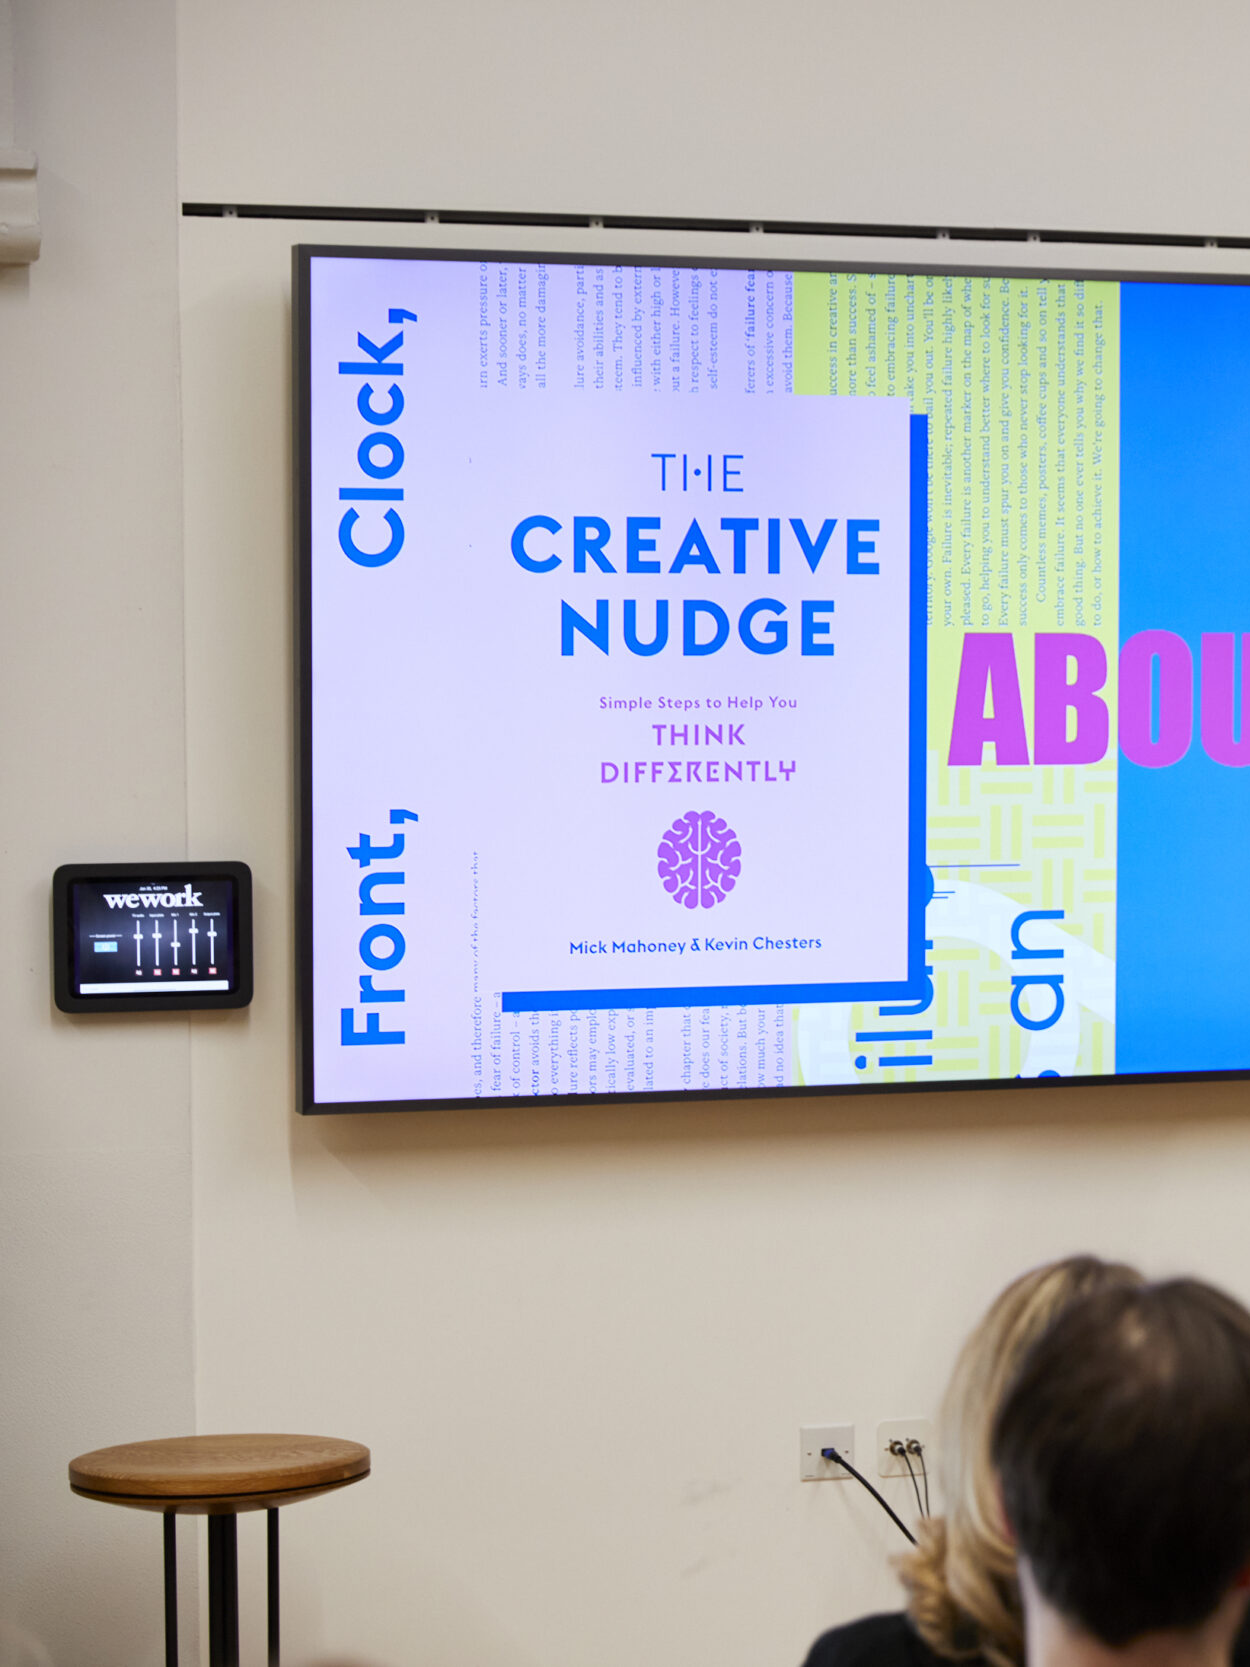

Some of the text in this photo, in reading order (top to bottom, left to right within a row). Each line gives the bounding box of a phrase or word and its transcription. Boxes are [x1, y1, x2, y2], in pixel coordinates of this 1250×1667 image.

[517, 267, 527, 309] matter
[709, 281, 719, 301] not
[782, 273, 793, 321] Because
[1054, 281, 1067, 310] that
[498, 301, 508, 315] or
[518, 311, 527, 327] no
[611, 275, 627, 353] They tend to
[706, 303, 719, 319] do
[828, 288, 838, 338] creative
[1016, 301, 1029, 319] for
[498, 317, 508, 359] sooner
[592, 268, 605, 389] their abilities and as
[650, 274, 665, 387] with either high or
[687, 274, 703, 384] respect to feelings
[765, 281, 775, 387] excessive concern
[864, 290, 877, 390] feel ashamed of
[1016, 321, 1032, 366] looking
[534, 316, 547, 389] all the more
[630, 306, 646, 387] influenced by
[845, 338, 857, 367] than
[884, 316, 900, 382] embracing
[1054, 310, 1067, 388] understands
[1091, 332, 1107, 376] change
[496, 361, 508, 386] And
[781, 361, 793, 393] avoid
[1019, 368, 1032, 395] stop
[1093, 377, 1104, 392] to
[1019, 397, 1029, 431] never
[1056, 388, 1069, 446] everyone
[1093, 393, 1106, 428] going
[338, 308, 417, 567] Clock,
[1016, 433, 1029, 459] who
[651, 454, 743, 491] THE
[1054, 447, 1066, 474] that
[1075, 460, 1085, 488] ever
[1016, 462, 1029, 495] those
[1056, 475, 1066, 515] seems
[1018, 497, 1029, 510] to
[1075, 489, 1085, 513] one
[1091, 483, 1103, 530] achieve
[1019, 512, 1029, 551] comes
[1054, 514, 1066, 528] It
[1075, 514, 1085, 531] no
[1093, 531, 1103, 545] to
[511, 515, 879, 574] CREATIVE
[1072, 533, 1085, 556] But
[1091, 546, 1103, 574] how
[1016, 553, 1031, 580] only
[1093, 575, 1103, 590] or
[1018, 582, 1028, 627] success
[1053, 575, 1065, 628] embrace
[1072, 596, 1087, 628] good
[561, 597, 834, 656] NUDGE
[1092, 613, 1103, 627] to
[599, 696, 797, 711] Simple Steps to Help You
[652, 724, 746, 746] THINK
[103, 883, 204, 909] wework
[341, 809, 418, 1046] Front,
[569, 936, 822, 955] Mick Mahoney & Kevin Chesters
[626, 1015, 636, 1029] or
[773, 1005, 785, 1072] no idea that
[489, 1011, 502, 1092] fear of failure
[680, 1014, 695, 1085] chapter that
